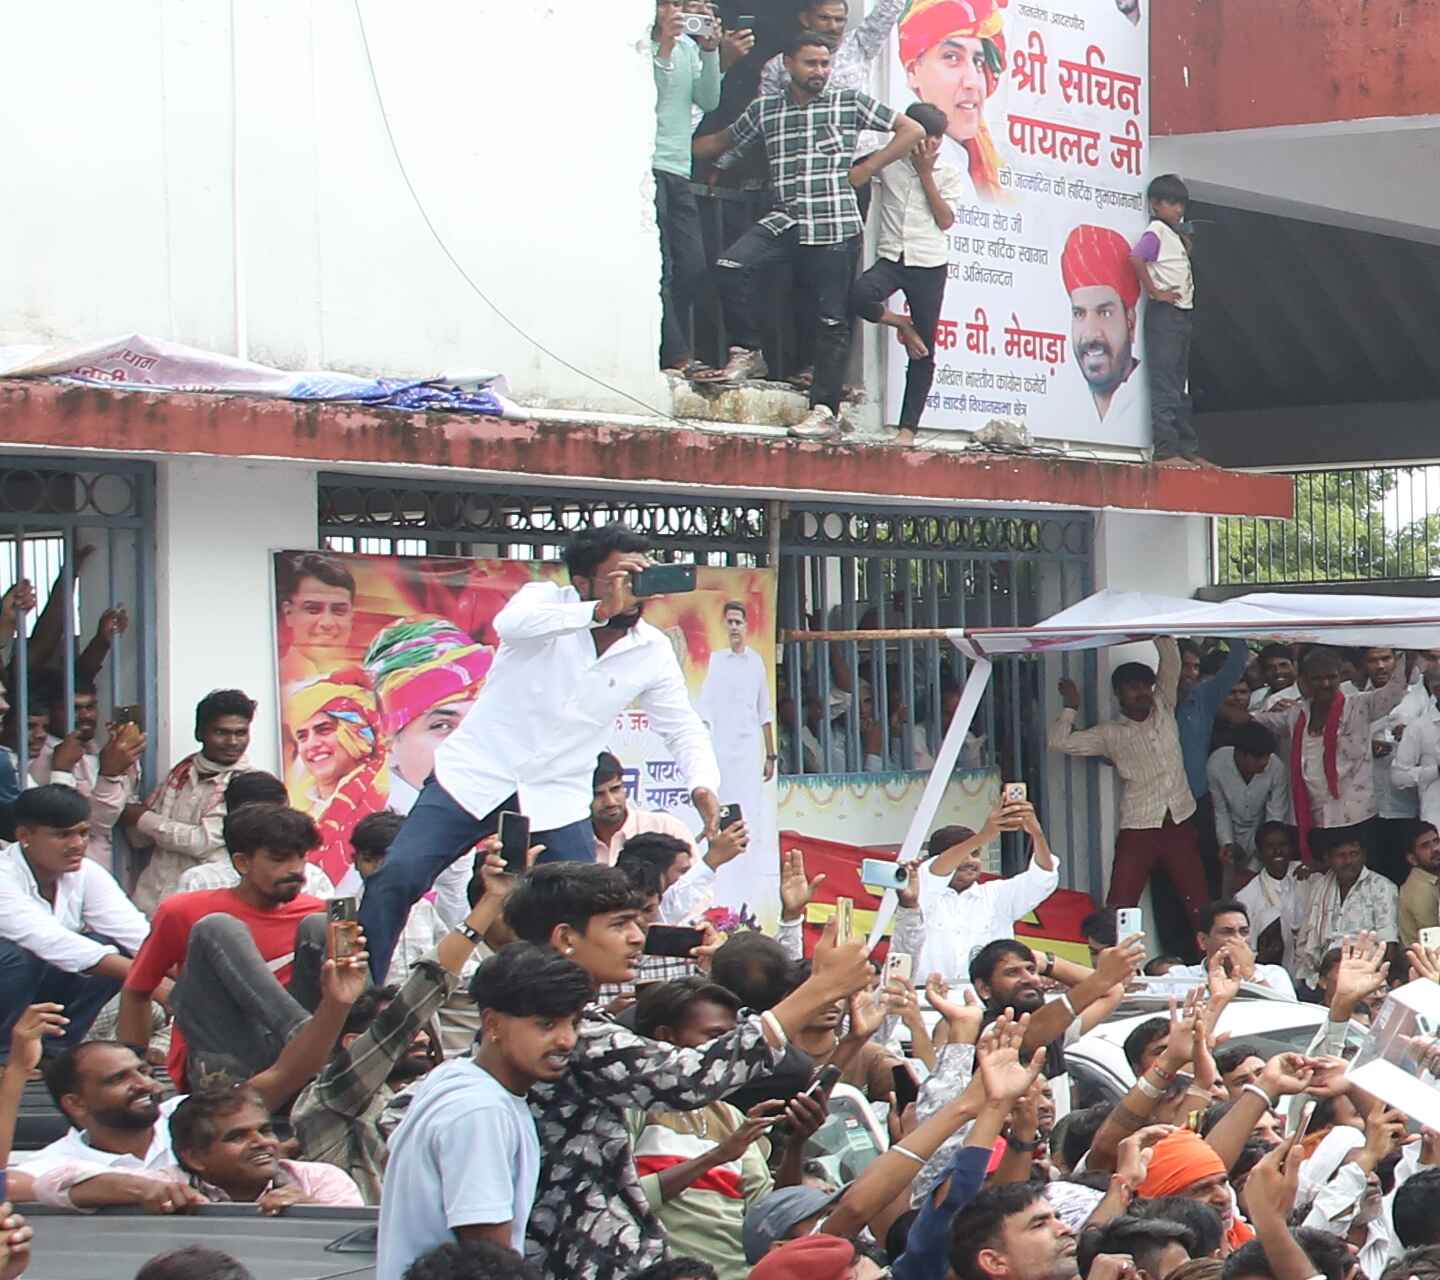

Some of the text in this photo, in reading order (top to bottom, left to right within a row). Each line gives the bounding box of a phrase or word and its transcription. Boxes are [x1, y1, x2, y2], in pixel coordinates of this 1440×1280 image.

[1011, 31, 1141, 115] श्री सचिन
[1007, 114, 1143, 176] पायलट जी
[999, 165, 1012, 188] को
[1015, 171, 1051, 194] जन्मदिन
[1053, 176, 1066, 196] की
[1068, 178, 1093, 201] हार्दिक
[972, 238, 985, 257] पर
[988, 236, 1016, 260] हार्दिक
[1018, 246, 1048, 265] स्वागत
[963, 260, 1013, 288] अभिनन्दन
[966, 307, 996, 356] बी.
[1004, 311, 1067, 376] मेवाड़ा
[645, 787, 693, 809] साहब
